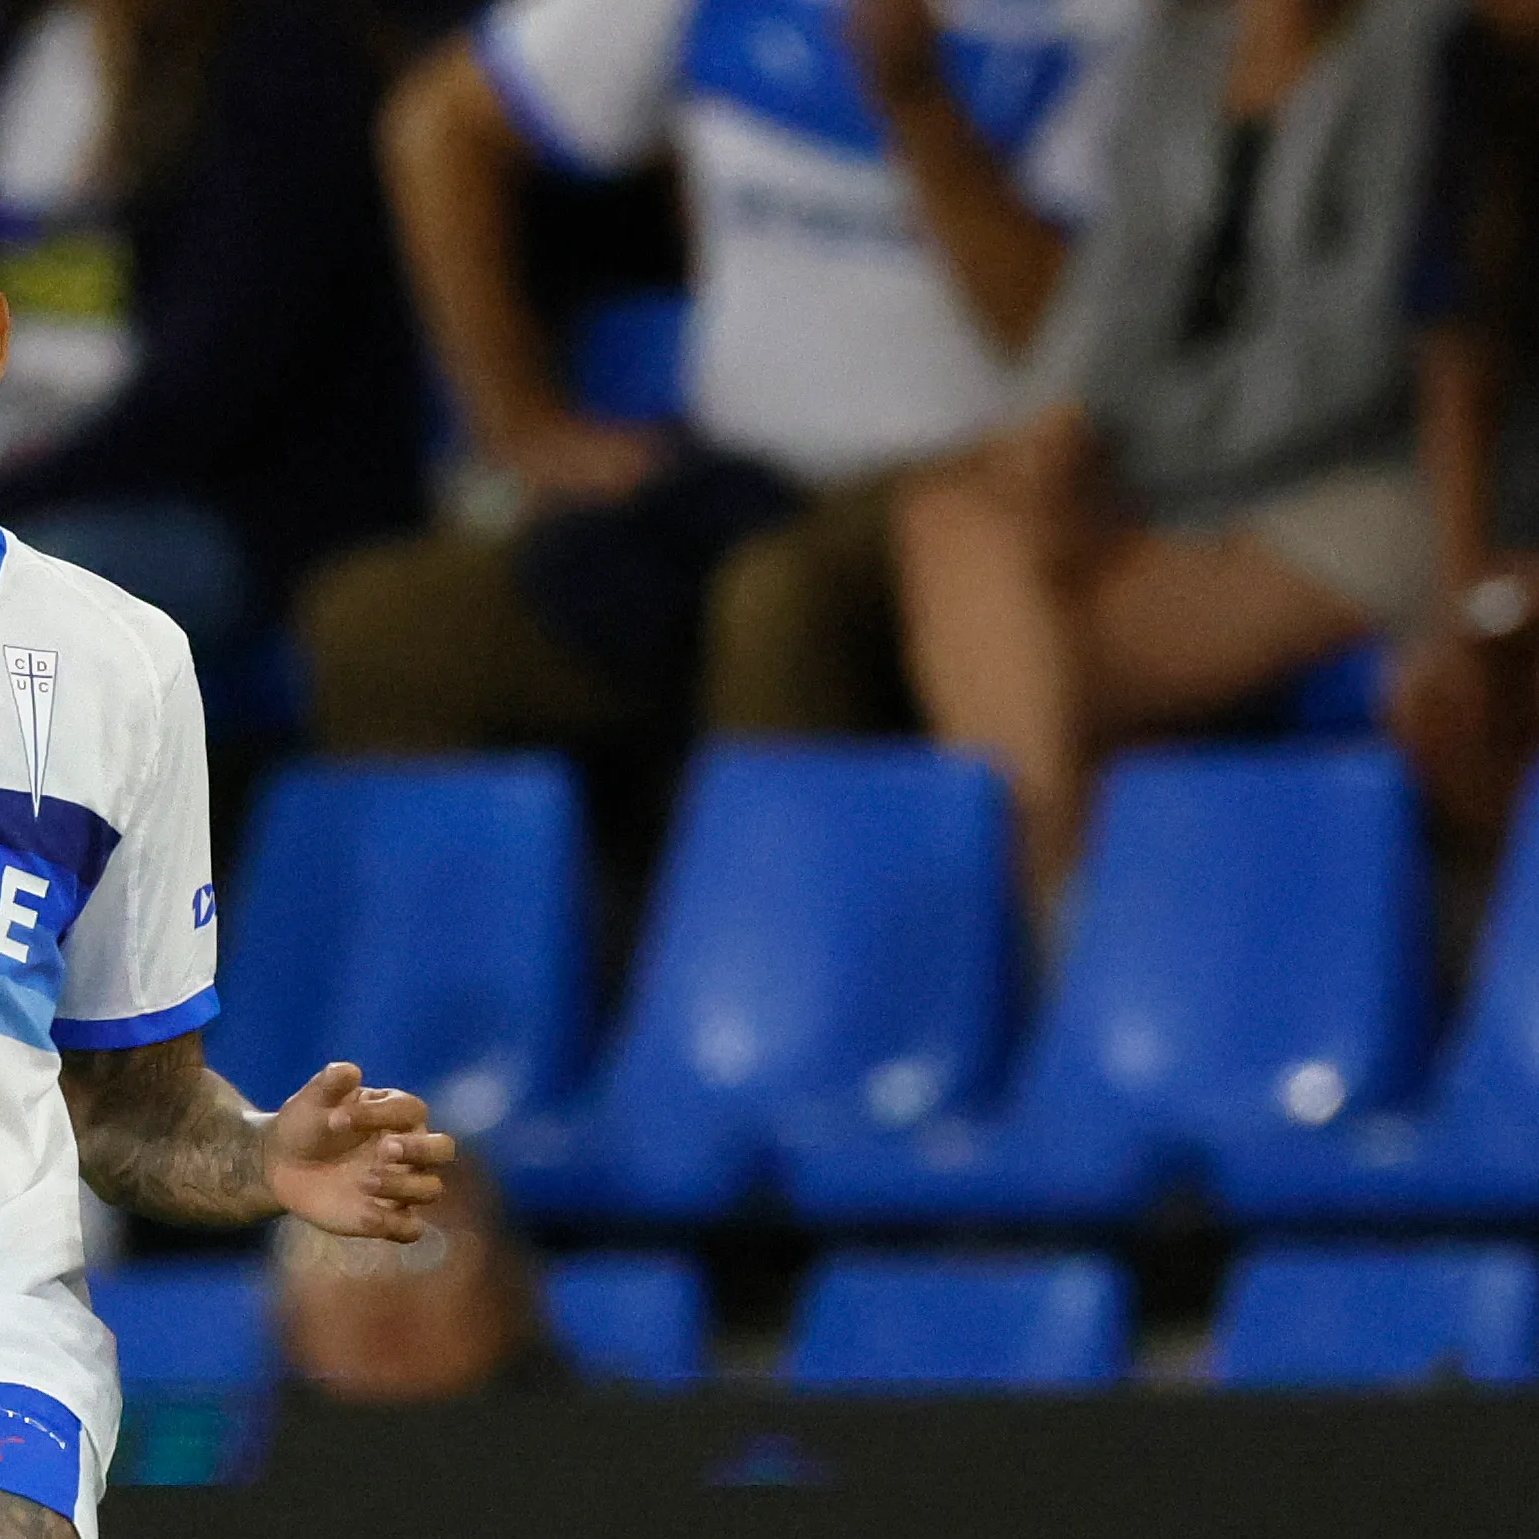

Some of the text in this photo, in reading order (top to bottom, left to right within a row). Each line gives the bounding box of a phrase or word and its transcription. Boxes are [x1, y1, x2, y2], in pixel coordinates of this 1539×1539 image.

[15, 658, 47, 672] C D
[17, 680, 49, 693] U C
